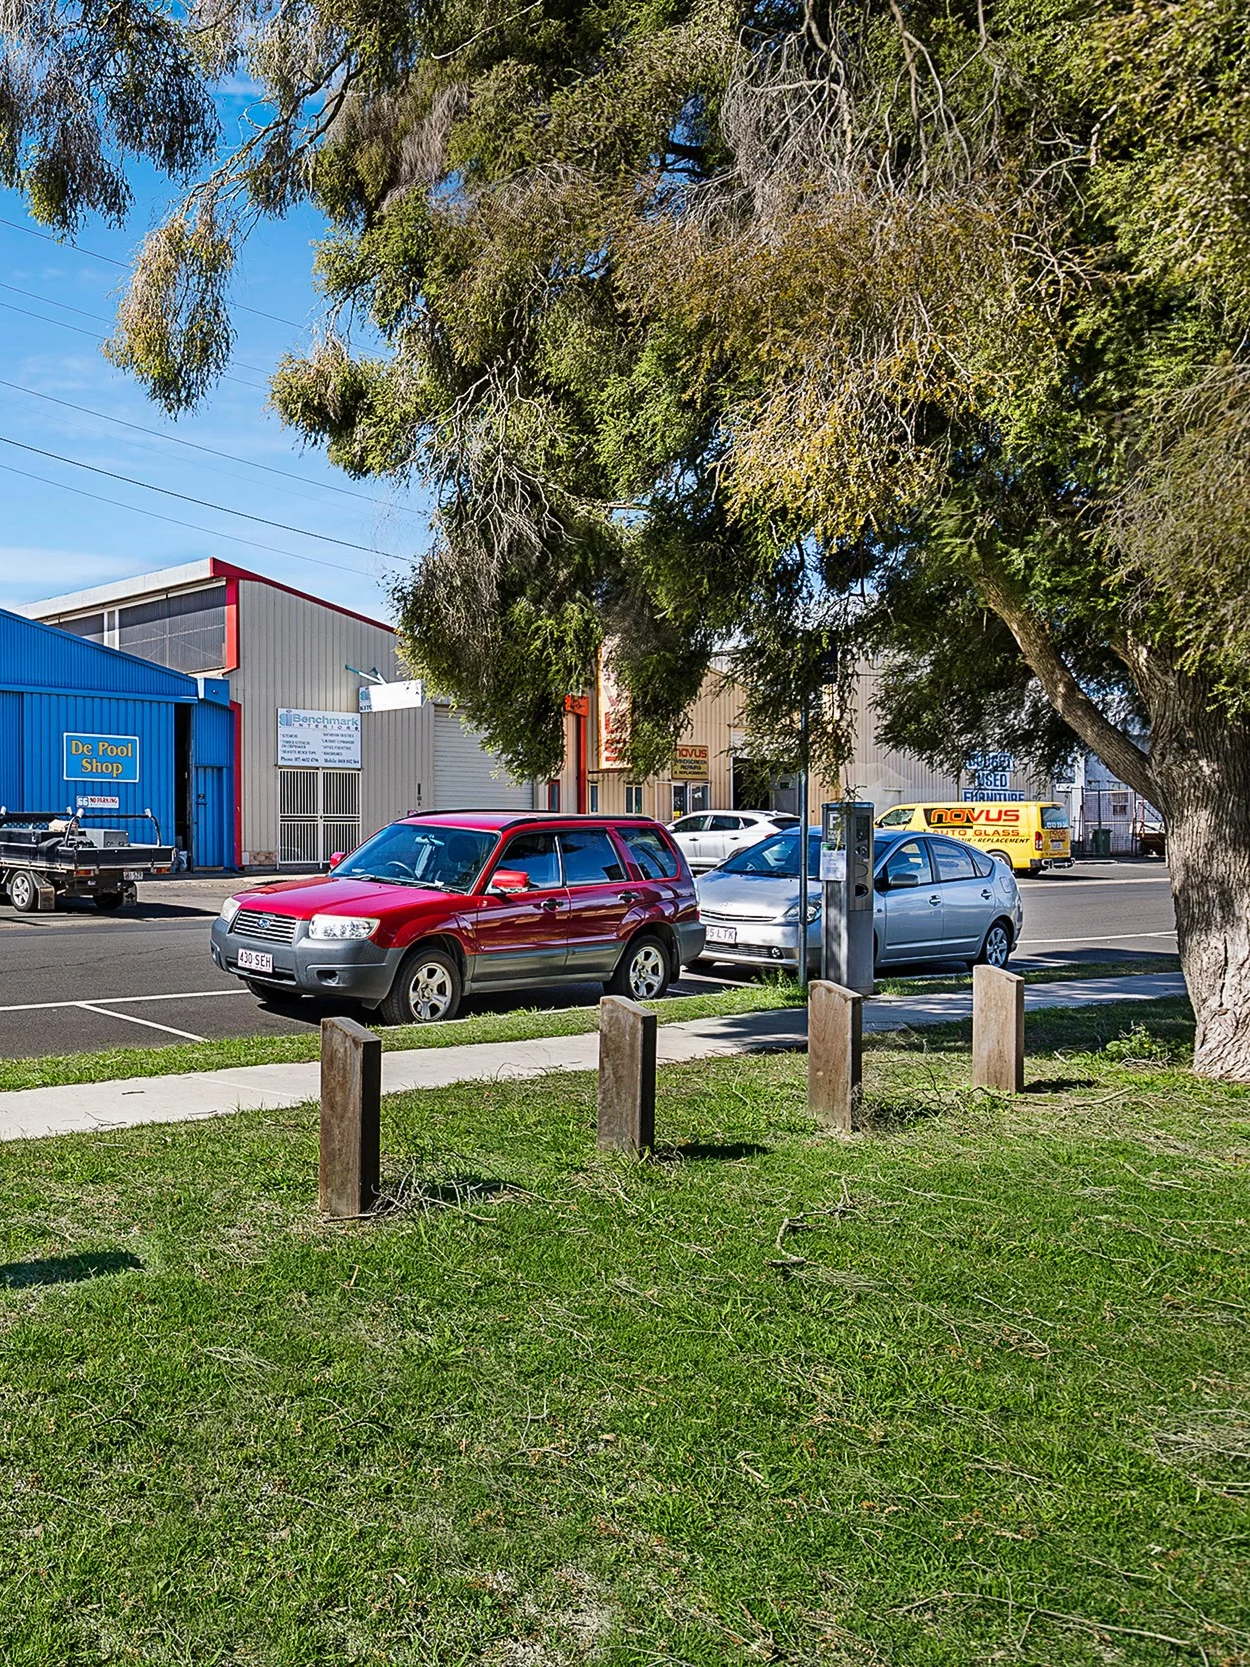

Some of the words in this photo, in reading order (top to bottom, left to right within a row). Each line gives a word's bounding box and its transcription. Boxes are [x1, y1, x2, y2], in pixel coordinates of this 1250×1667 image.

[292, 713, 359, 726] Benchmark
[71, 740, 93, 756] De
[98, 741, 132, 757] Pool
[81, 758, 123, 777] Shop
[976, 773, 1008, 787] USED
[963, 791, 1025, 802] FURNITURE
[933, 829, 967, 837] AUTO
[974, 829, 1020, 837] GLASS
[255, 954, 271, 968] SEH
